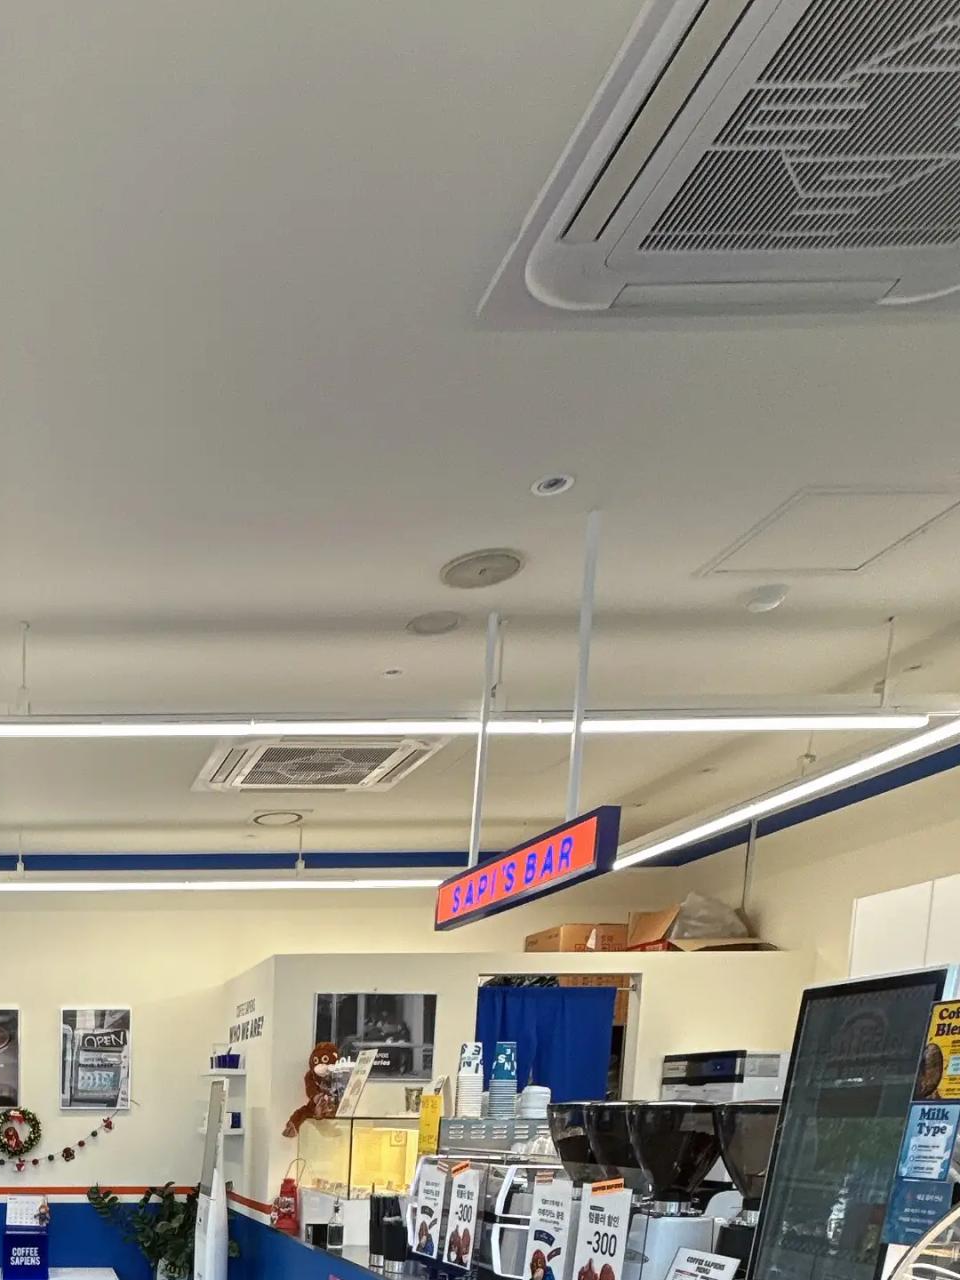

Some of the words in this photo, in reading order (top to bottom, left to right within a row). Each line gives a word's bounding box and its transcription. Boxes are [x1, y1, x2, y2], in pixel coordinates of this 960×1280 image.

[451, 861, 517, 913] SAPI'S
[524, 836, 574, 885] BAR
[241, 1020, 250, 1041] WE
[84, 1031, 125, 1048] OPEN
[919, 1107, 950, 1121] Milk
[917, 1122, 947, 1137] Type
[455, 1204, 473, 1223] -300
[12, 1247, 39, 1257] COFFEE
[586, 1231, 617, 1257] -300
[10, 1257, 41, 1266] SAPIENS
